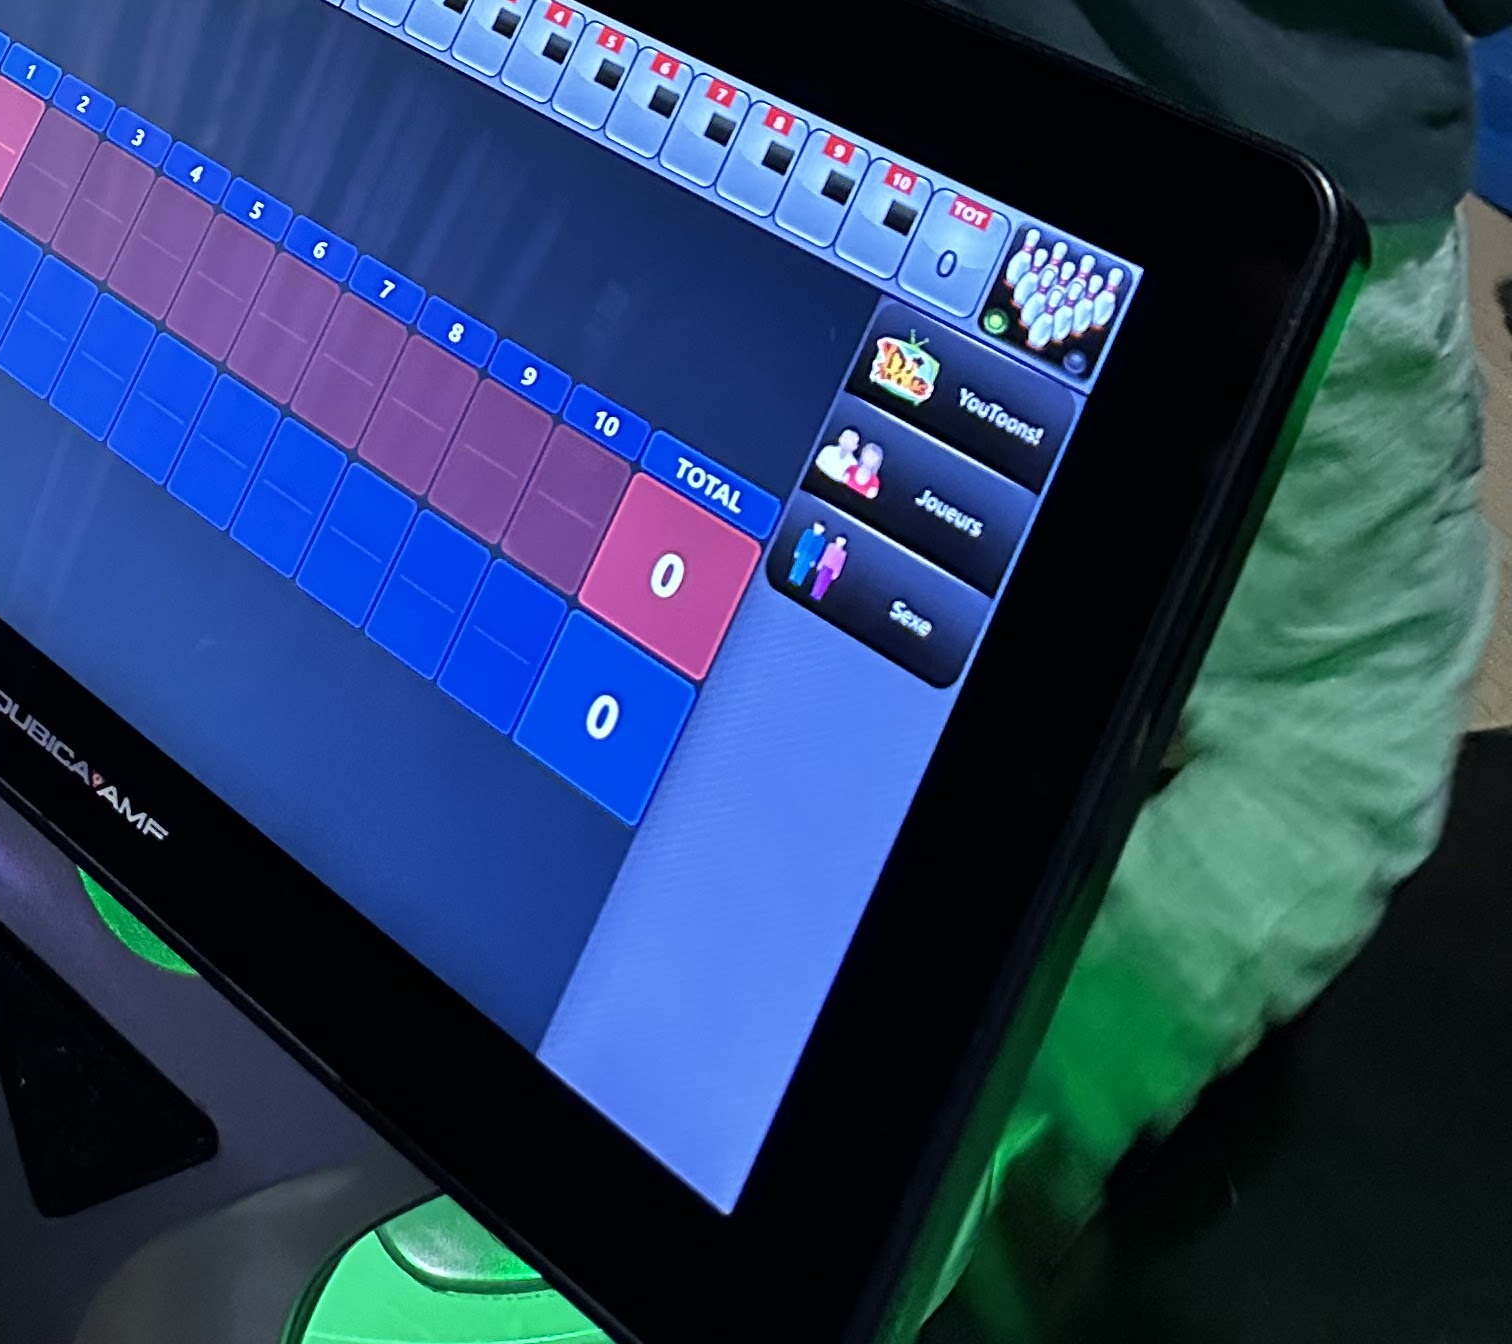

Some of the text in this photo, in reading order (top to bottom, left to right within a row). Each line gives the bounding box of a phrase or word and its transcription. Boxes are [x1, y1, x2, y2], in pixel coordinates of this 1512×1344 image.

[553, 9, 566, 24] 4
[605, 34, 618, 49] 5
[658, 61, 672, 75] 6
[718, 87, 730, 102] 7
[772, 115, 785, 130] 8
[833, 143, 846, 158] 9
[892, 172, 912, 191] 10
[953, 200, 989, 226] TOT
[935, 249, 958, 278] 0
[26, 64, 37, 80] 1
[76, 95, 90, 114] 2
[130, 128, 146, 147] 3
[189, 165, 204, 183] 4
[248, 201, 265, 220] 5
[312, 241, 328, 259] 6
[379, 279, 396, 299] 7
[448, 322, 465, 343] 8
[520, 366, 538, 386] 9
[594, 410, 620, 439] 10
[675, 457, 743, 515] TOTAL
[958, 387, 1045, 447] YouToons!
[914, 488, 984, 538] Joueurs
[650, 553, 685, 599] 0
[889, 600, 933, 639] Sexe
[586, 694, 620, 740] 0
[96, 785, 169, 841] AMF
